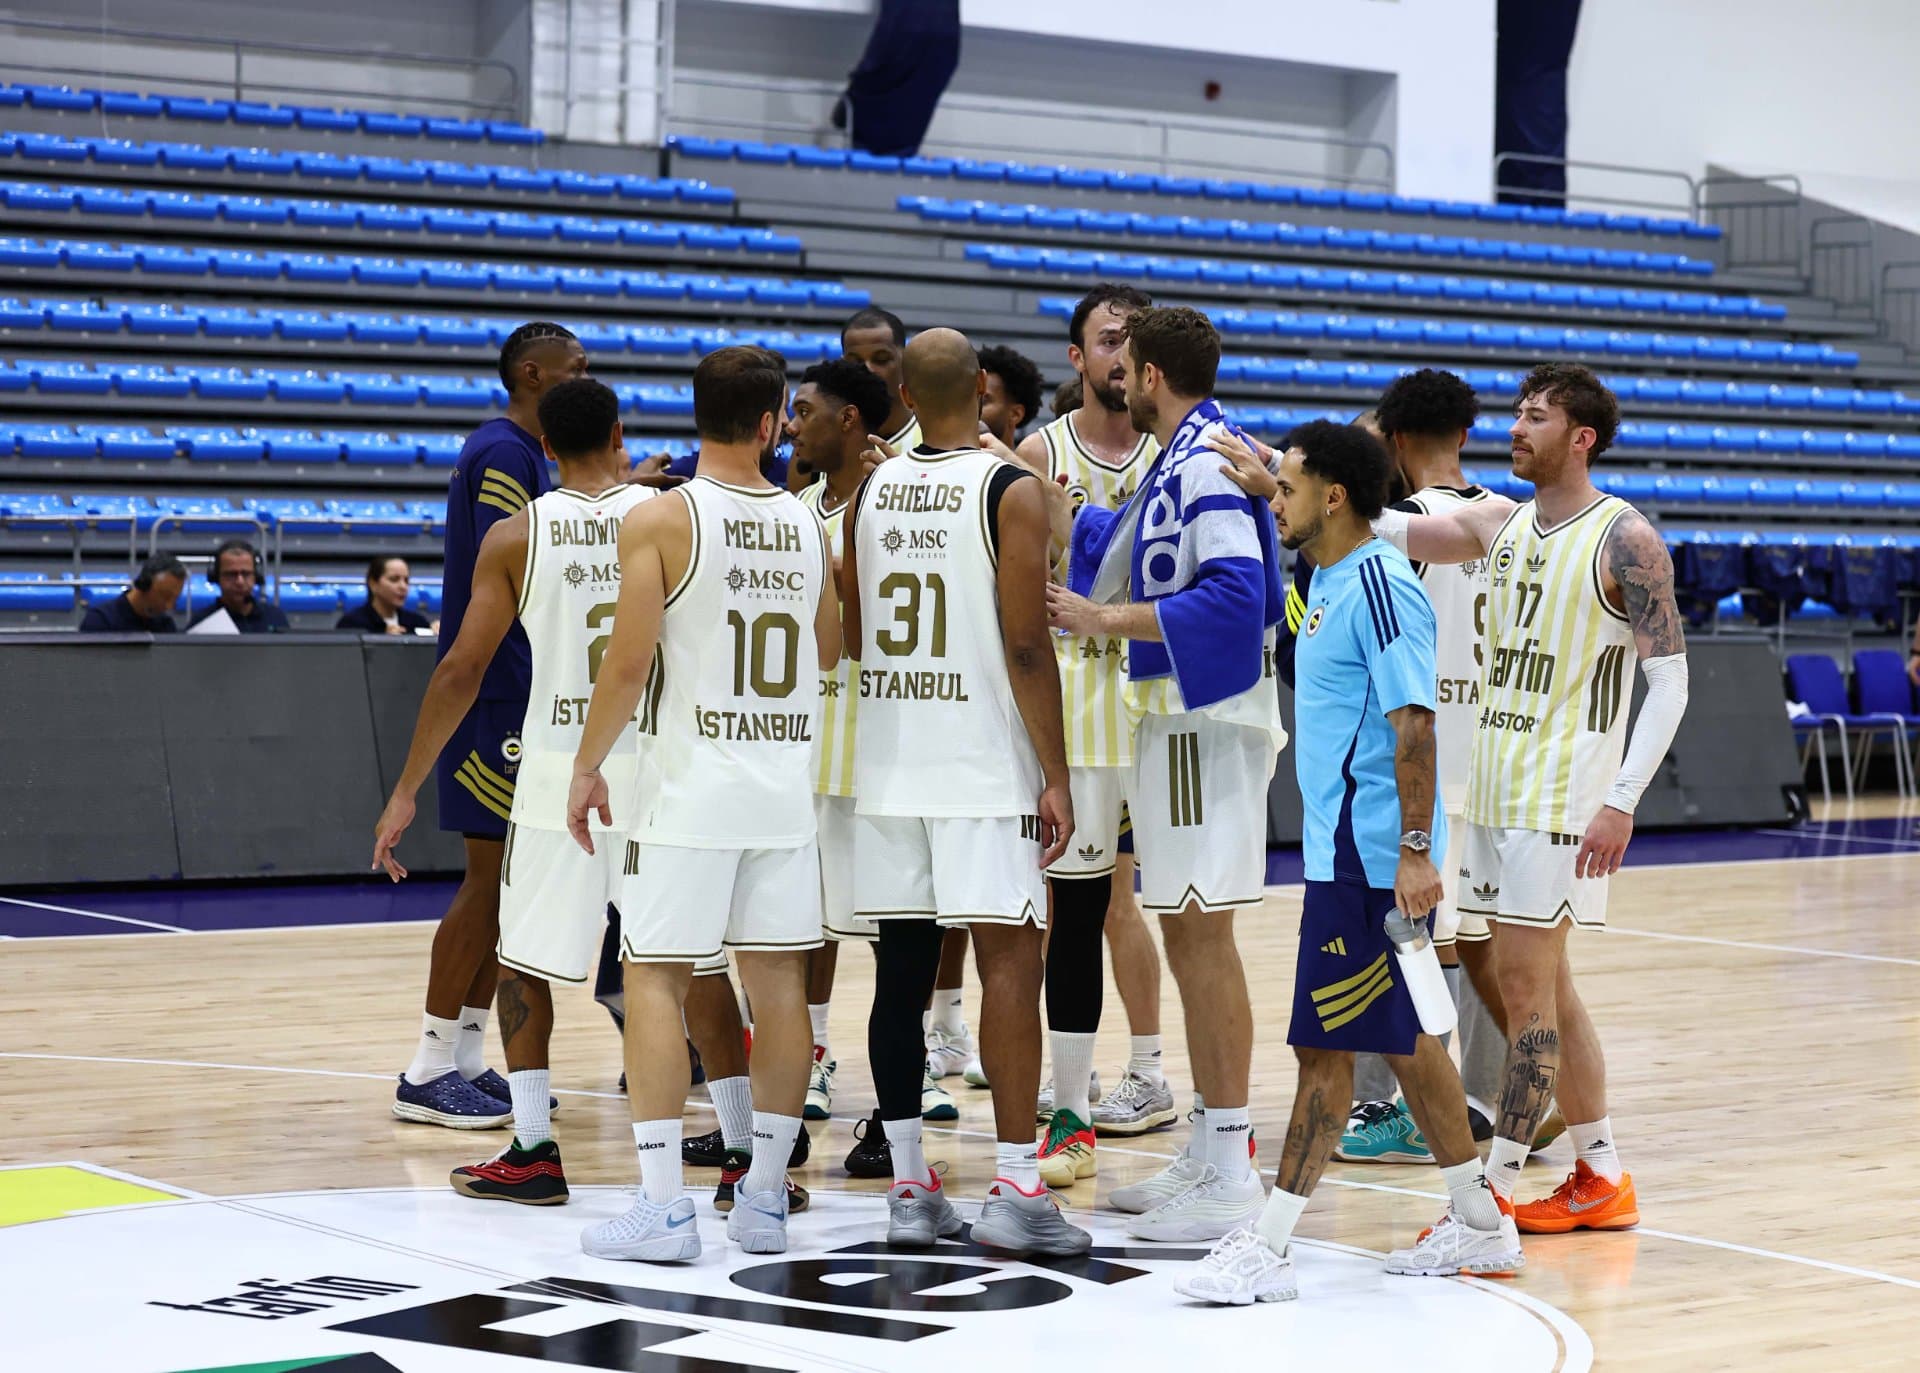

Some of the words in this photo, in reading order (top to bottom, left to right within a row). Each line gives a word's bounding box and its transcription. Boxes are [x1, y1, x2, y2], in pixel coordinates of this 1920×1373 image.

[875, 483, 965, 513] SHIELDS
[723, 517, 801, 552] MELİH
[908, 529, 948, 549] MSC
[590, 562, 622, 582] MS
[748, 569, 804, 591] MSC
[876, 572, 946, 657] 31
[1516, 581, 1543, 628] 17
[727, 609, 800, 698] 10
[859, 668, 969, 702] STANBUL
[695, 705, 812, 742] İSTANBUL
[1488, 710, 1536, 733] ASTOR
[1216, 1123, 1249, 1133] adida
[638, 1141, 666, 1151] idas
[145, 1275, 423, 1321] tarfin
